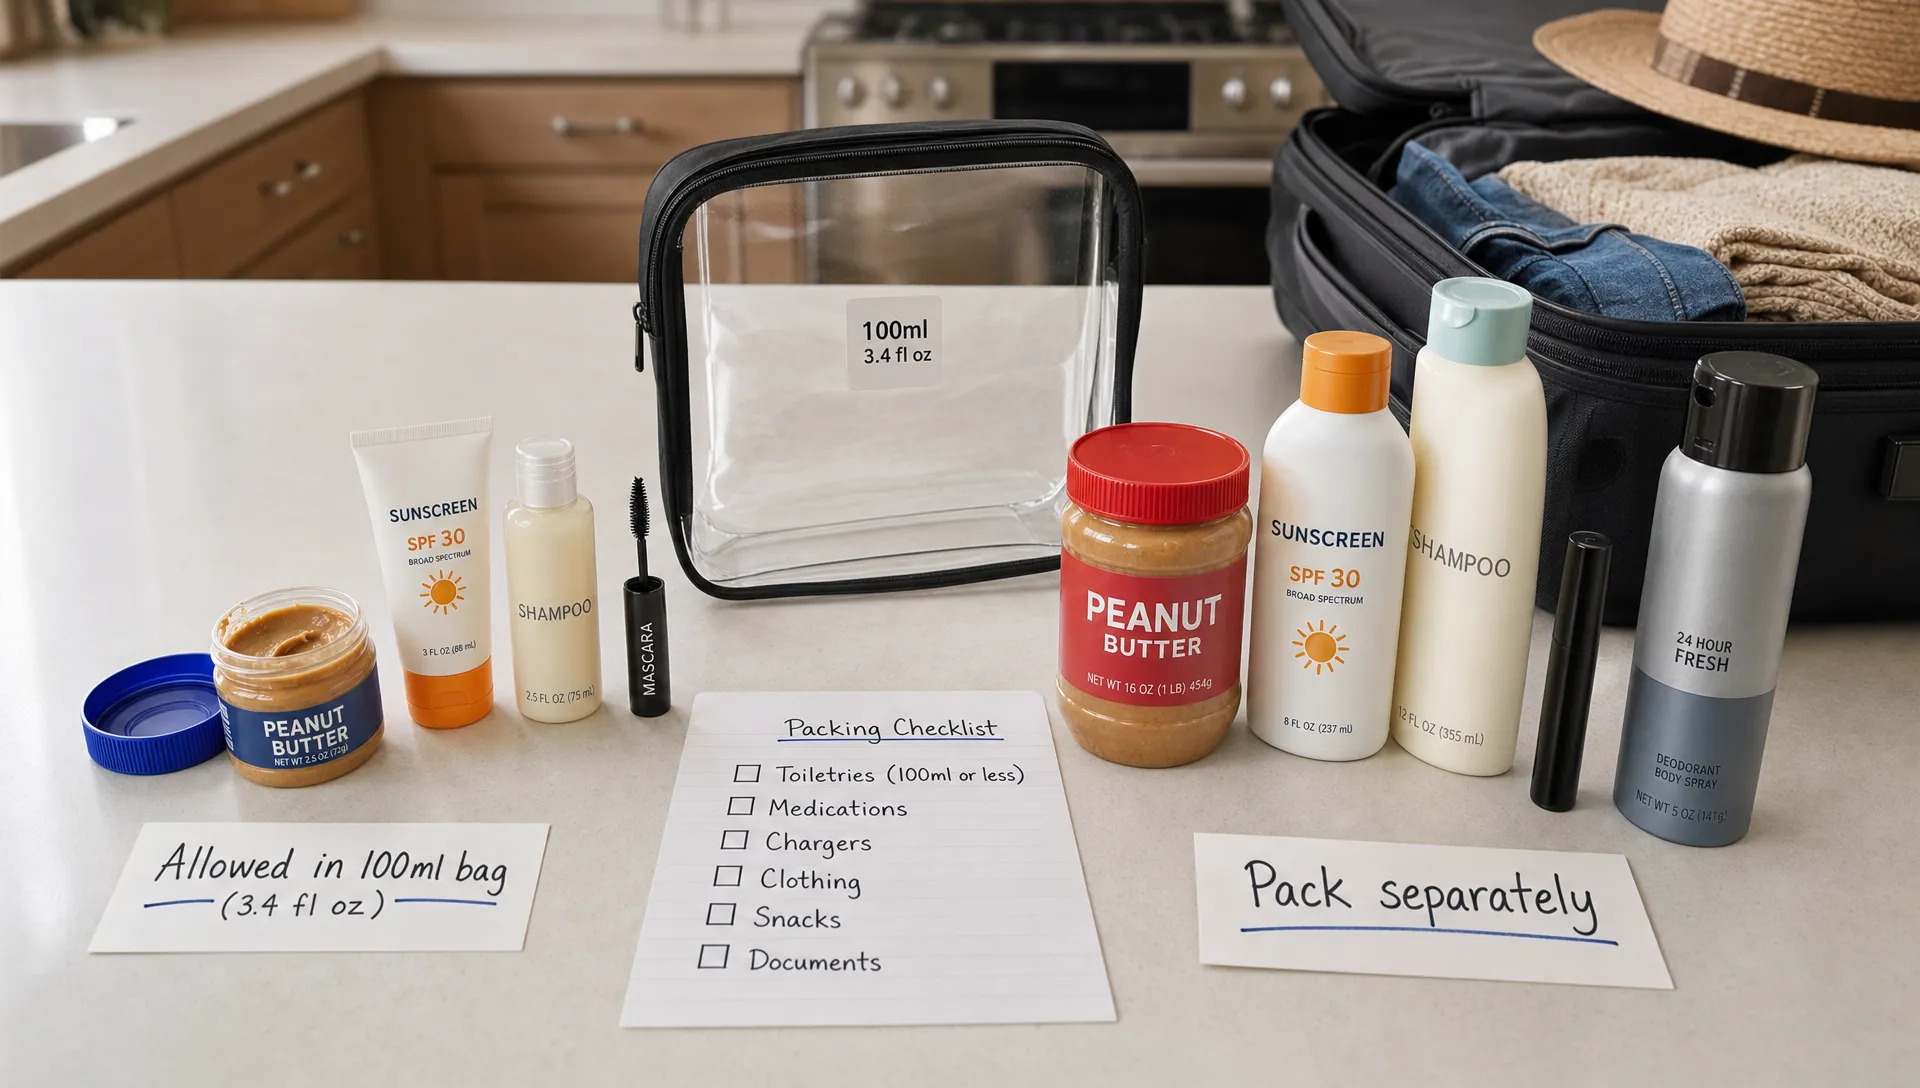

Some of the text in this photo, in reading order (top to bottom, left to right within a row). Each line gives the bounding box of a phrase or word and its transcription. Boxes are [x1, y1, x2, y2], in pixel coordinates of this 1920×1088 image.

[862, 319, 927, 340] 100ml
[864, 346, 932, 364] 3.4 fl oz
[389, 497, 478, 523] SUNSCREEN
[407, 527, 466, 551] SPF 30
[1271, 519, 1385, 548] SUNSCREEN
[408, 549, 472, 566] BROAD SPECTRUM
[1289, 565, 1361, 589] SPF 30
[1286, 588, 1364, 605] BROAD SPECTRUM
[518, 598, 592, 621] SHAMPOO
[1087, 589, 1222, 633] PEANUT
[422, 648, 428, 656] 3
[429, 648, 438, 656] FL
[440, 646, 450, 655] OZ
[1104, 633, 1201, 659] BUTTER
[1676, 631, 1733, 654] 24 HOUR
[640, 622, 656, 696] MASCARA
[1674, 647, 1730, 672] FRESH
[1087, 672, 1104, 687] NET
[1106, 678, 1122, 691] WT
[1124, 682, 1136, 694] 16
[1139, 684, 1154, 695] OZ
[1170, 682, 1186, 695] LB)
[526, 690, 538, 702] 2.5
[539, 693, 550, 704] FL
[552, 693, 565, 704] OZ
[568, 690, 581, 704] (75
[263, 704, 345, 738] PEANUT
[783, 717, 998, 745] Packing Checklist
[1283, 716, 1289, 726] 8
[1291, 718, 1301, 729] FL
[1303, 721, 1315, 732] OZ
[1318, 723, 1338, 734] (237
[1399, 705, 1407, 721] 12
[1408, 712, 1420, 729] FL
[1422, 720, 1436, 735] OZ
[1439, 725, 1462, 742] (355
[271, 725, 349, 756] BUTTER
[274, 758, 289, 766] NET
[291, 756, 303, 765] WT
[318, 751, 329, 760] OZ
[1656, 753, 1721, 776] DEODORANT
[775, 763, 1025, 786] Toiletries (100ml or less)
[1654, 767, 1719, 790] BODY SPRAY
[769, 798, 908, 817] Medications
[1636, 789, 1653, 806] NET
[1654, 798, 1670, 814] WT
[1671, 805, 1678, 817] 5
[1681, 808, 1695, 820] OZ
[765, 831, 872, 860] Chargers
[154, 842, 508, 896] Allowed in 100ml bag
[760, 867, 861, 900] Clothing
[220, 890, 278, 921] (3.4
[292, 892, 317, 917] fl
[1244, 859, 1599, 937] Pack separately
[753, 905, 842, 929] Snacks
[748, 948, 882, 973] Documents
